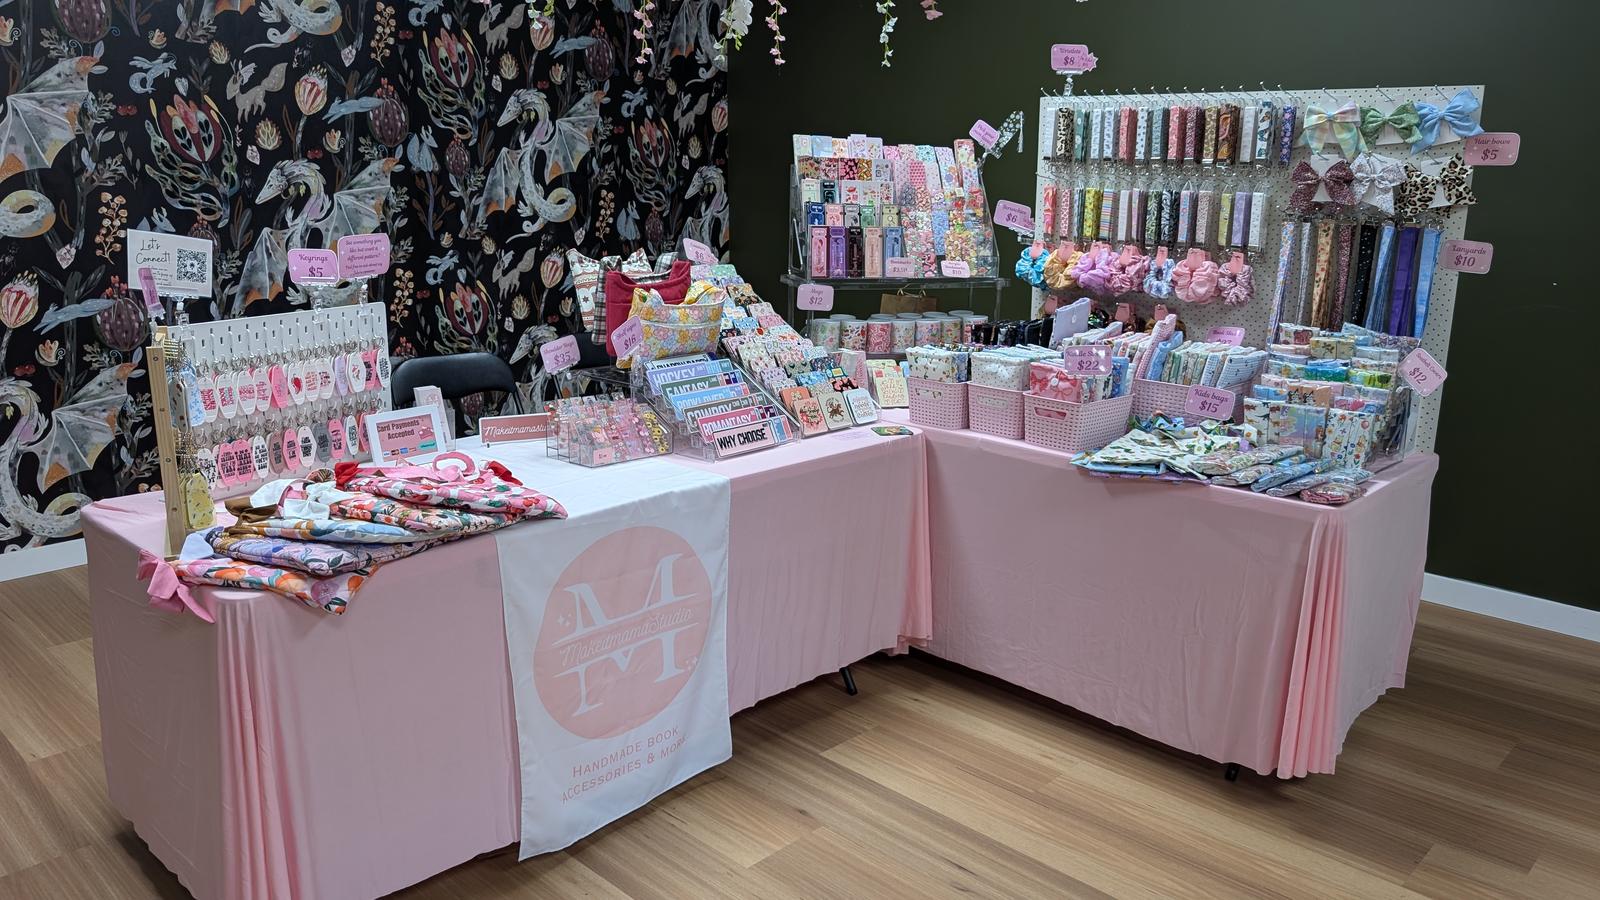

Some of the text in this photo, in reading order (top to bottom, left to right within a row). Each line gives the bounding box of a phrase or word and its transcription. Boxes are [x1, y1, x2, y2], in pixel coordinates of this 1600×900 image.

[1064, 56, 1075, 66] $8
[1481, 148, 1499, 161] $5
[1005, 212, 1018, 223] $6
[140, 238, 161, 251] Let's
[1452, 244, 1487, 255] Lanyards
[298, 253, 329, 264] Keyrings
[1454, 254, 1476, 267] $10
[308, 265, 324, 277] $5
[809, 296, 824, 305] $12
[623, 334, 638, 350] $16
[553, 351, 572, 366] $35
[1077, 359, 1100, 371] $22
[1408, 367, 1427, 385] $12
[665, 380, 709, 398] FANTASY
[1194, 388, 1229, 403] Kids bags
[1199, 400, 1220, 413] $15
[686, 402, 732, 427] COWBOY
[376, 420, 420, 433] Card Payments
[702, 413, 752, 437] ROMANTASY
[387, 429, 415, 440] Accepted
[717, 428, 768, 450] WHY CHOOSE
[572, 726, 680, 778] HANDMADE BOOK
[562, 759, 641, 804] ACCESSORIES
[646, 752, 655, 764] &
